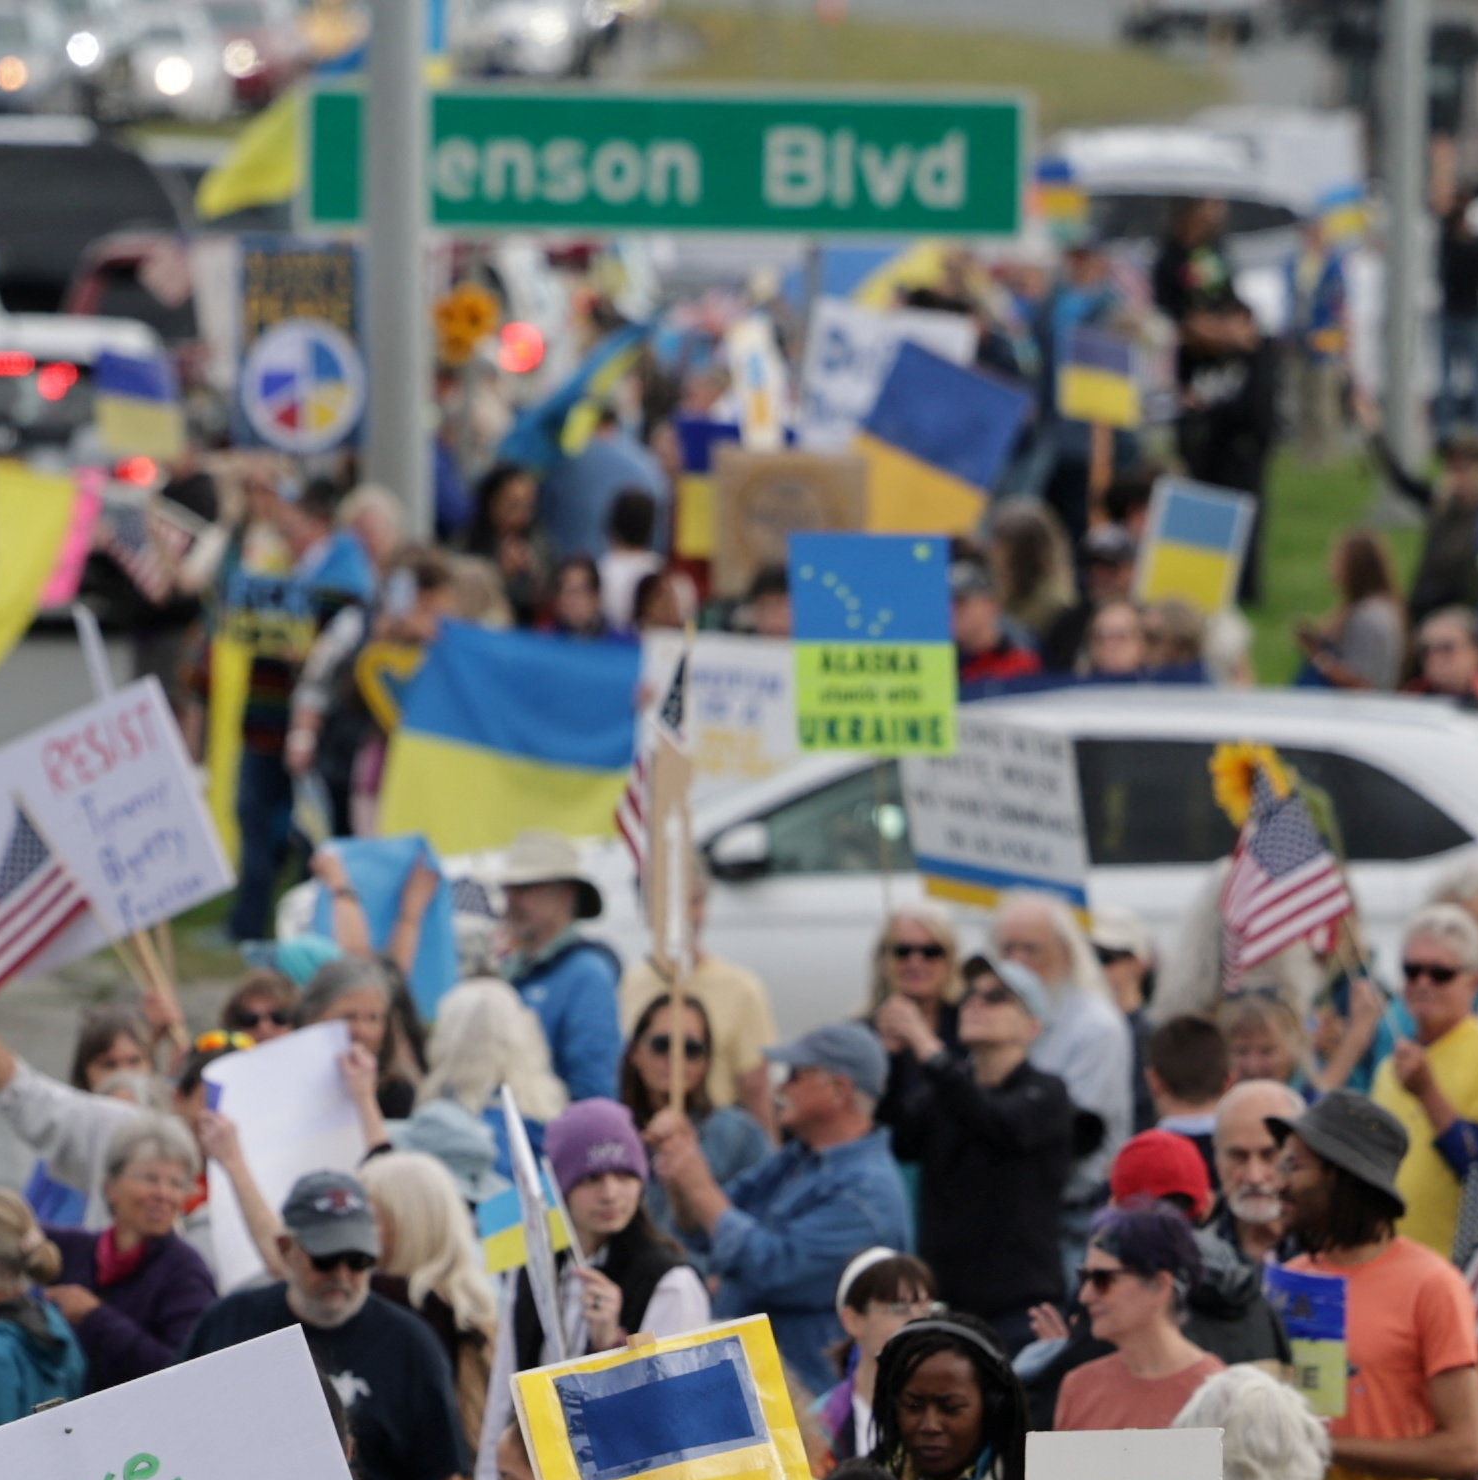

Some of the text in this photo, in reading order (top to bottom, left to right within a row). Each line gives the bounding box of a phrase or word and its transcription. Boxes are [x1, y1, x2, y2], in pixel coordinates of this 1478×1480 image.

[434, 126, 967, 209] enson Blvd
[821, 650, 919, 674] ALASKA
[42, 701, 156, 796] RESIST
[799, 716, 943, 748] UKRAINE
